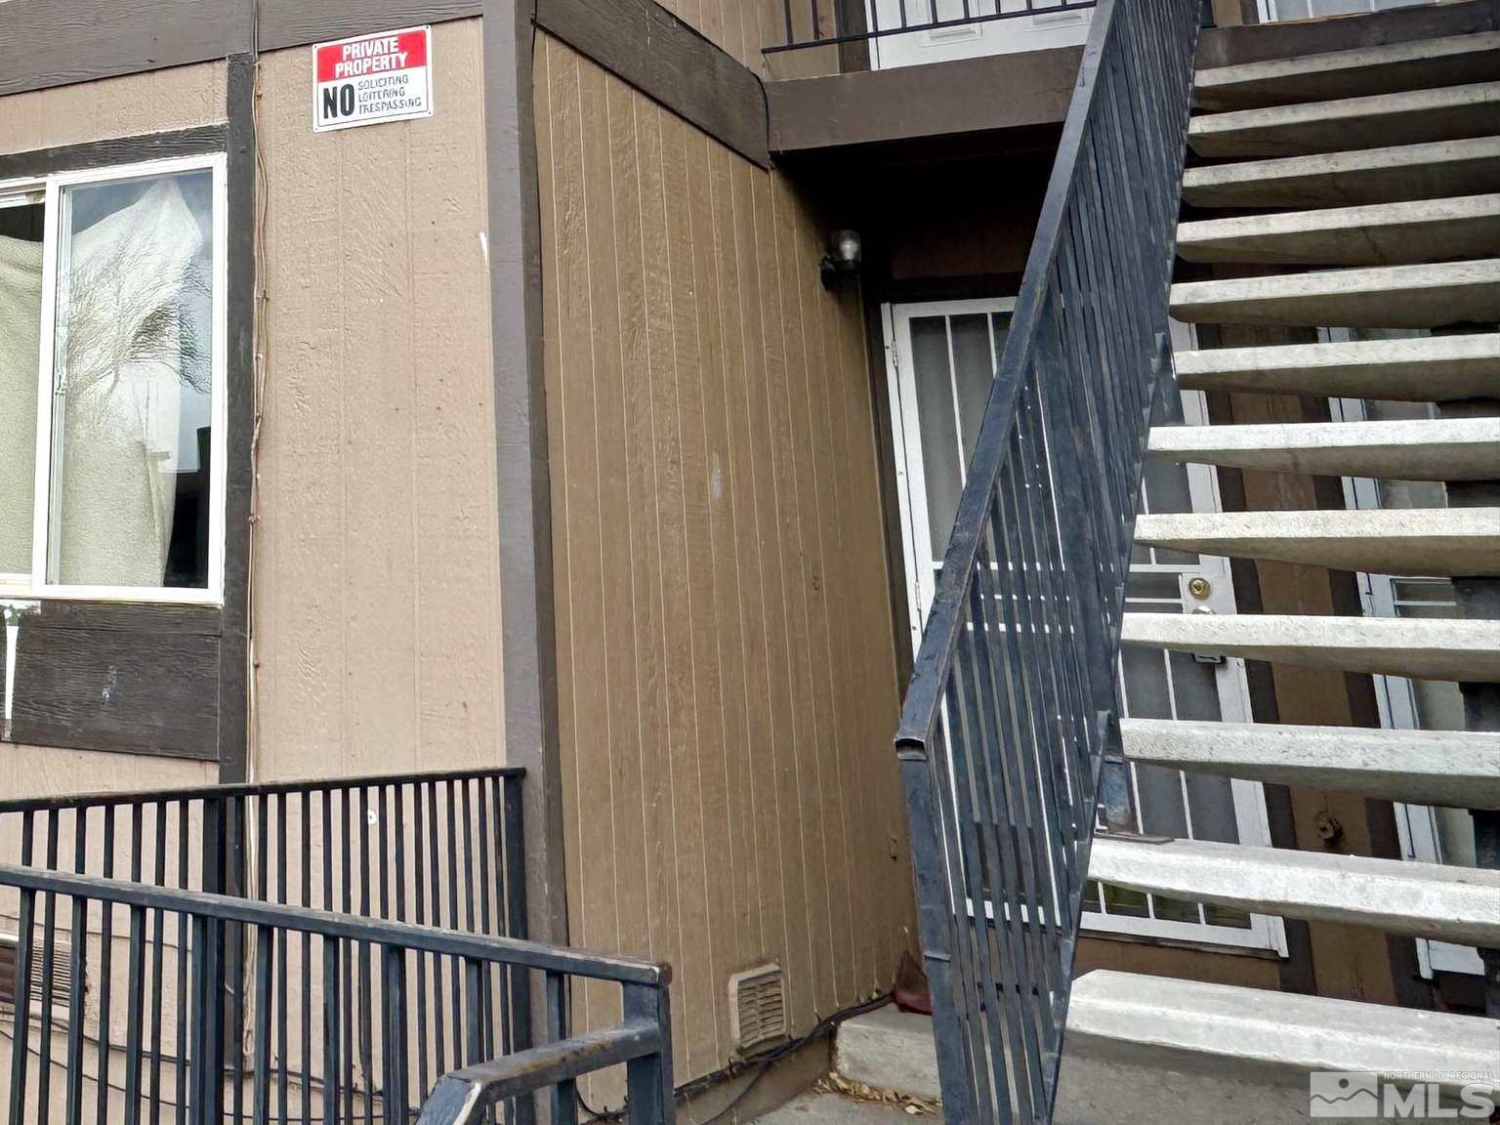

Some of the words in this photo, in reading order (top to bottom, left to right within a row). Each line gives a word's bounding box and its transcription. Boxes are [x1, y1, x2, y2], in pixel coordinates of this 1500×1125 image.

[342, 36, 399, 61] PRIVATE
[335, 52, 408, 79] PROPERTY
[357, 74, 409, 91] SOLICITING
[323, 83, 355, 119] NO
[358, 86, 406, 103] LOITERING
[358, 96, 422, 115] TRESPASSING
